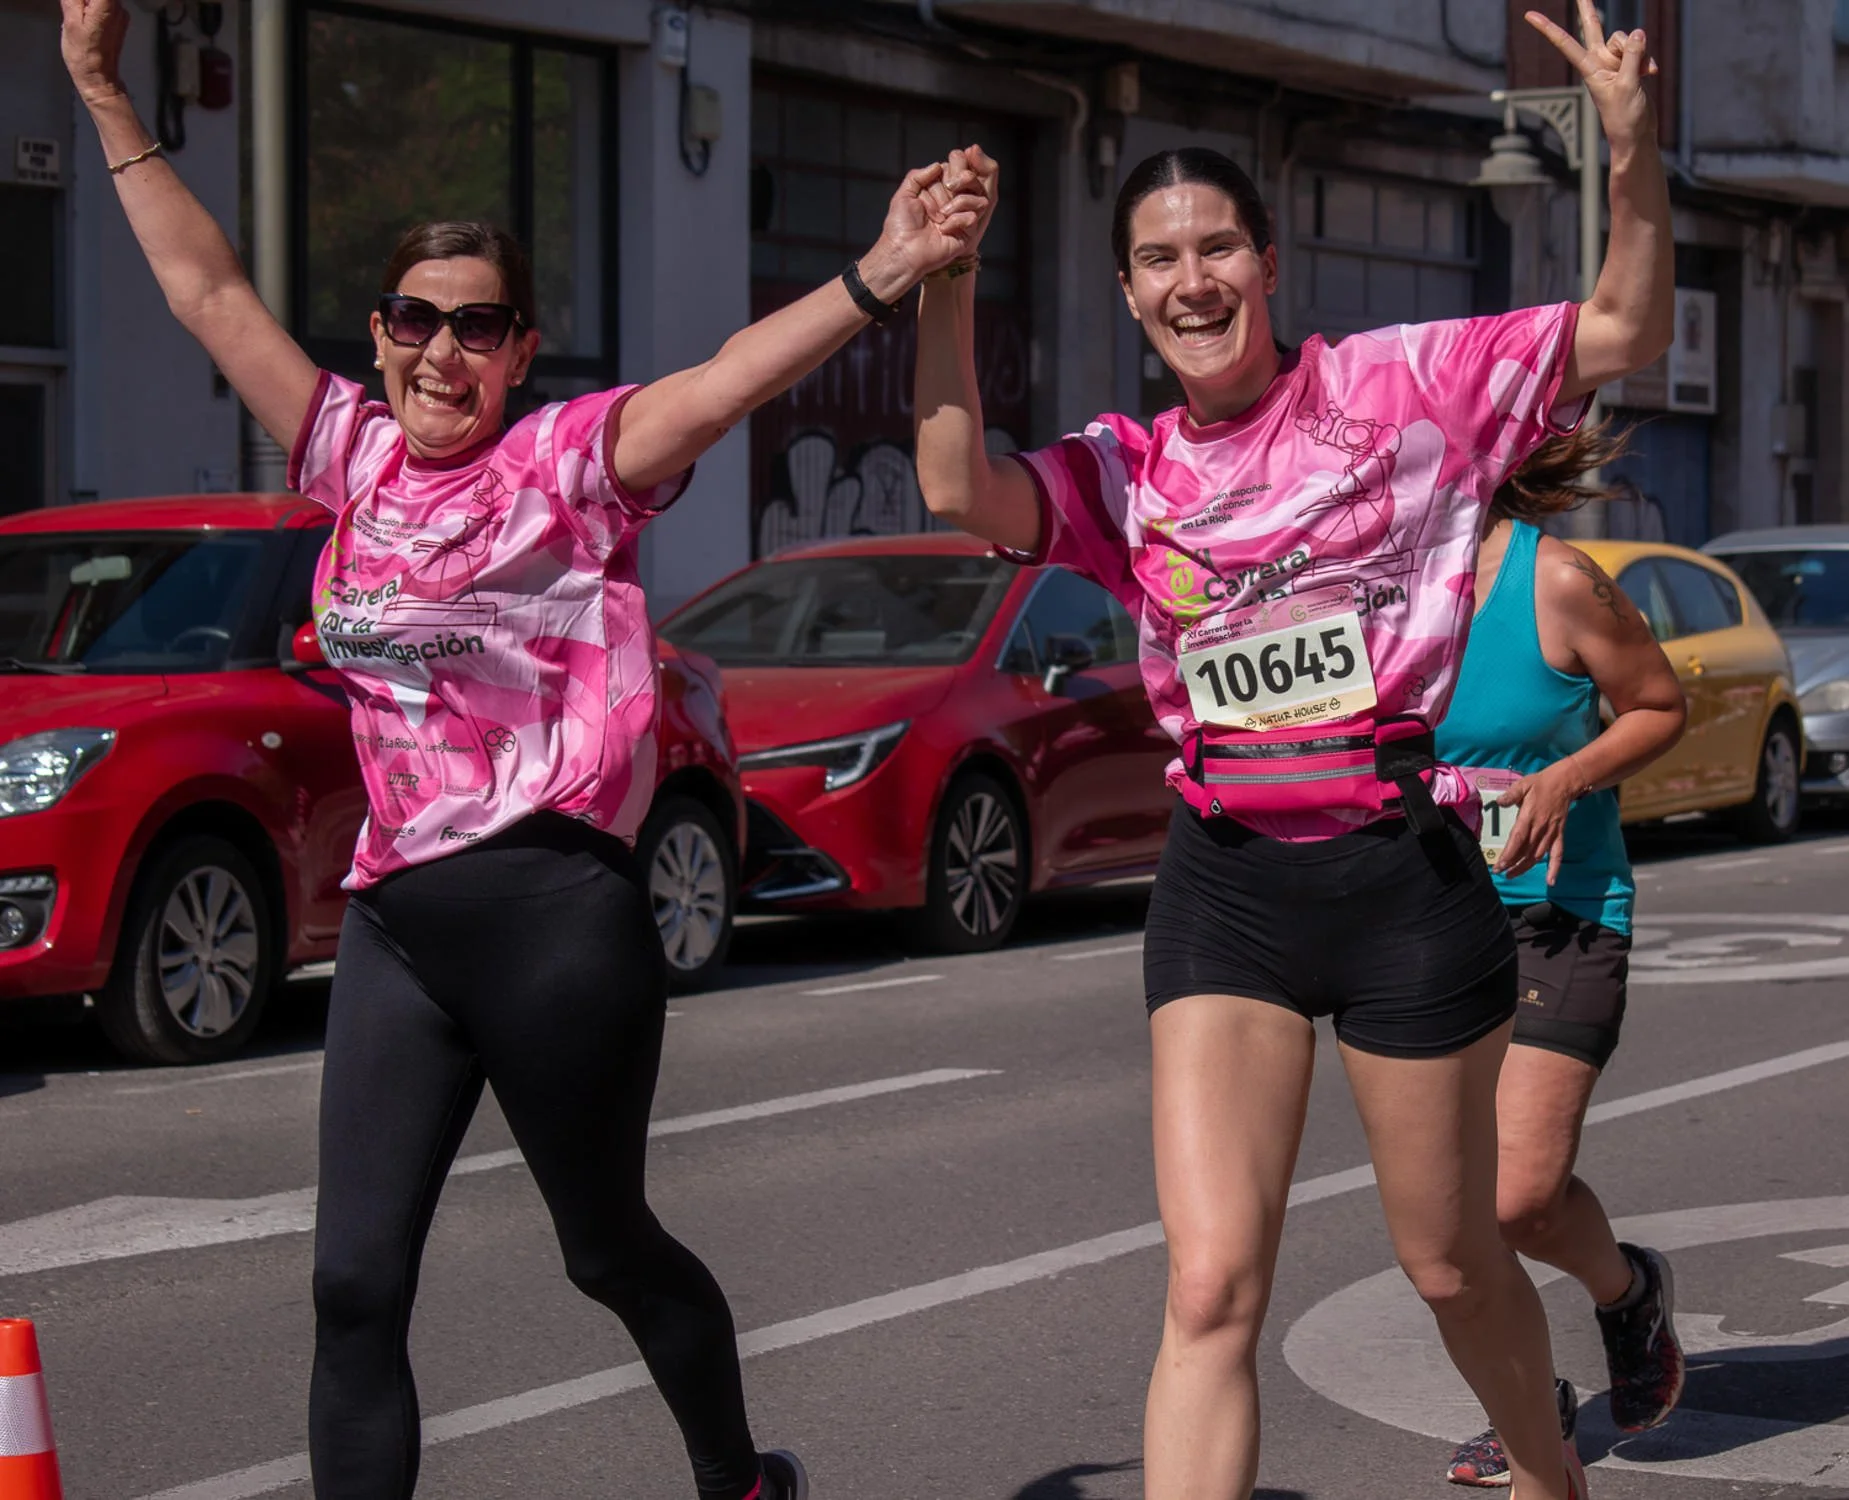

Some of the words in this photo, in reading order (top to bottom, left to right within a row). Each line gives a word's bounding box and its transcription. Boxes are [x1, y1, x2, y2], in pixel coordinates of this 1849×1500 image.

[1195, 517, 1208, 527] La
[1209, 513, 1233, 525] Rioja
[1203, 549, 1310, 602] Carrera
[1198, 625, 1229, 637] Carrera
[1229, 620, 1243, 632] por
[1195, 626, 1355, 707] 10645
